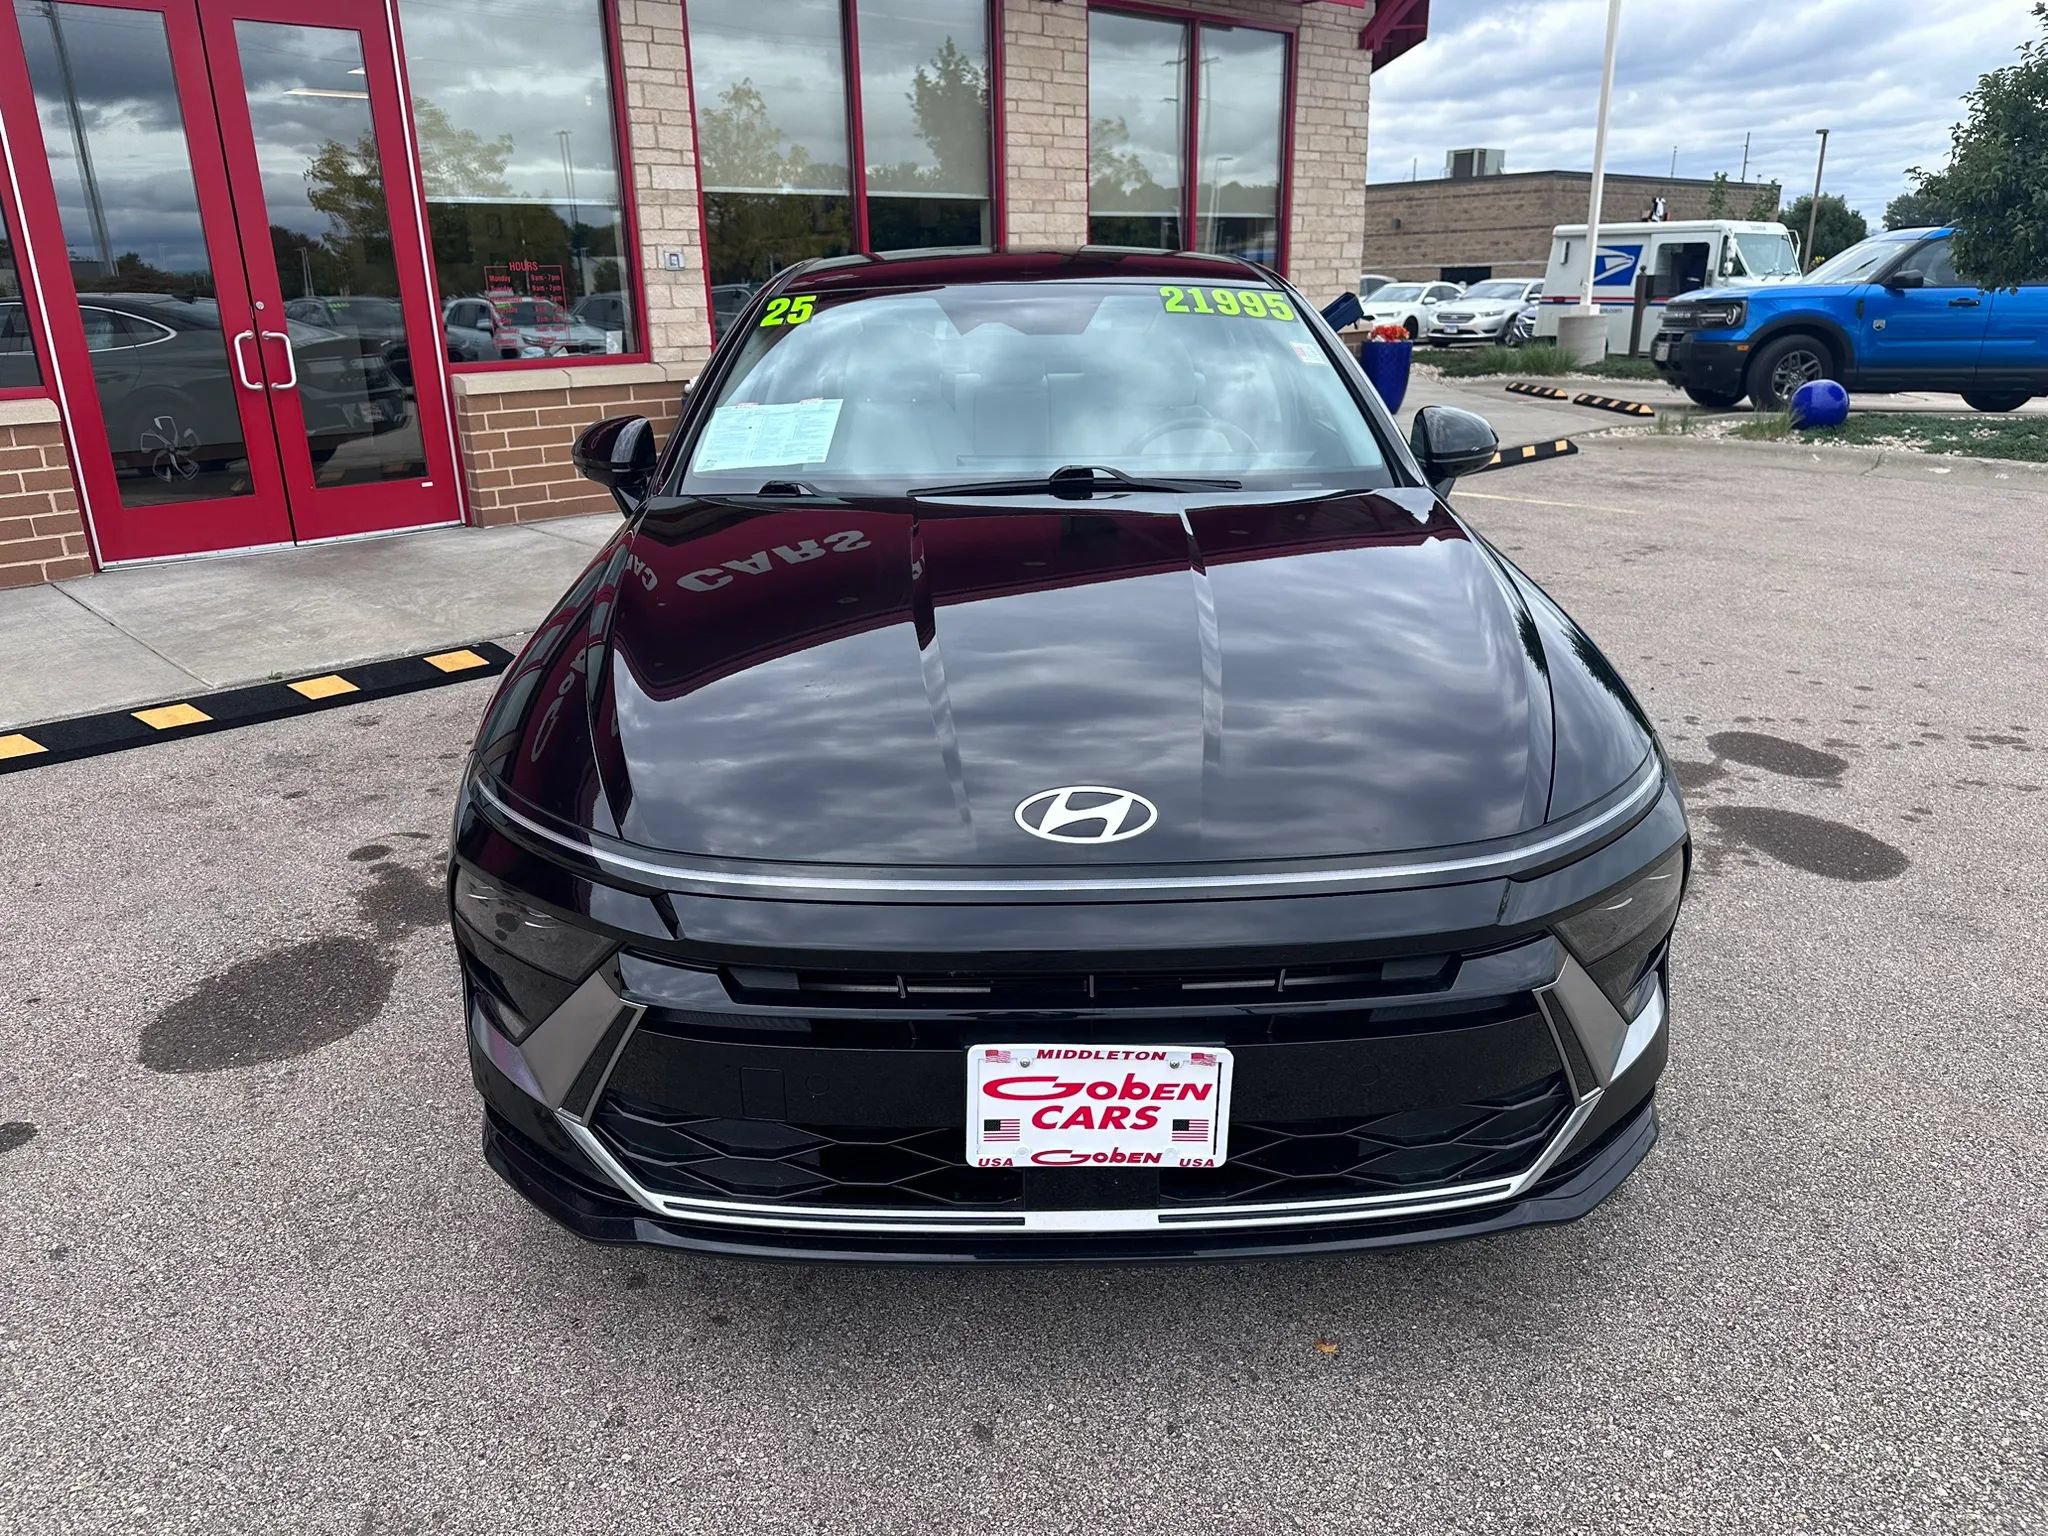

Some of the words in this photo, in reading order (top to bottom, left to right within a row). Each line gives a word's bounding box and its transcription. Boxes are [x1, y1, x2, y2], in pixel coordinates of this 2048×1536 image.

[508, 261, 538, 272] HOURS
[488, 275, 511, 283] Monday
[1159, 286, 1295, 321] 21995
[760, 295, 817, 327] 25
[1036, 1049, 1167, 1061] MIDDLETON
[1031, 1105, 1162, 1130] CARS
[978, 1157, 1014, 1167] USA
[1179, 1158, 1215, 1168] USA
